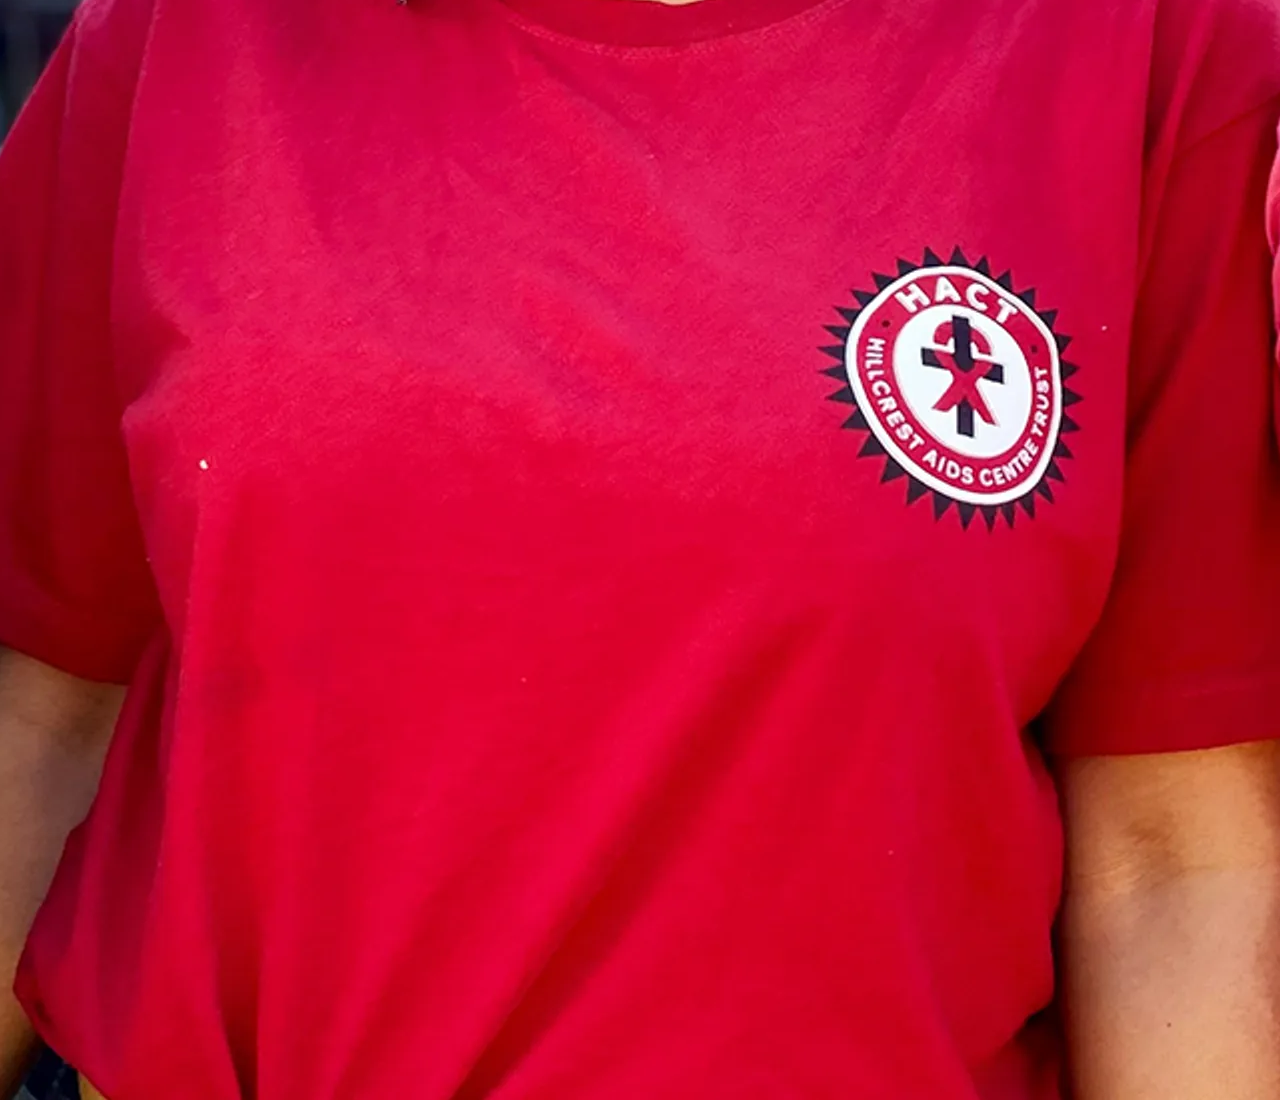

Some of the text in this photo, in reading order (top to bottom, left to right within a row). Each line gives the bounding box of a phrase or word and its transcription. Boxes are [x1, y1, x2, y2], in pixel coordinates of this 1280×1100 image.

[894, 275, 1018, 325] HACT
[865, 337, 1051, 487] HILLCREST AIDS CENTRE TRUST
